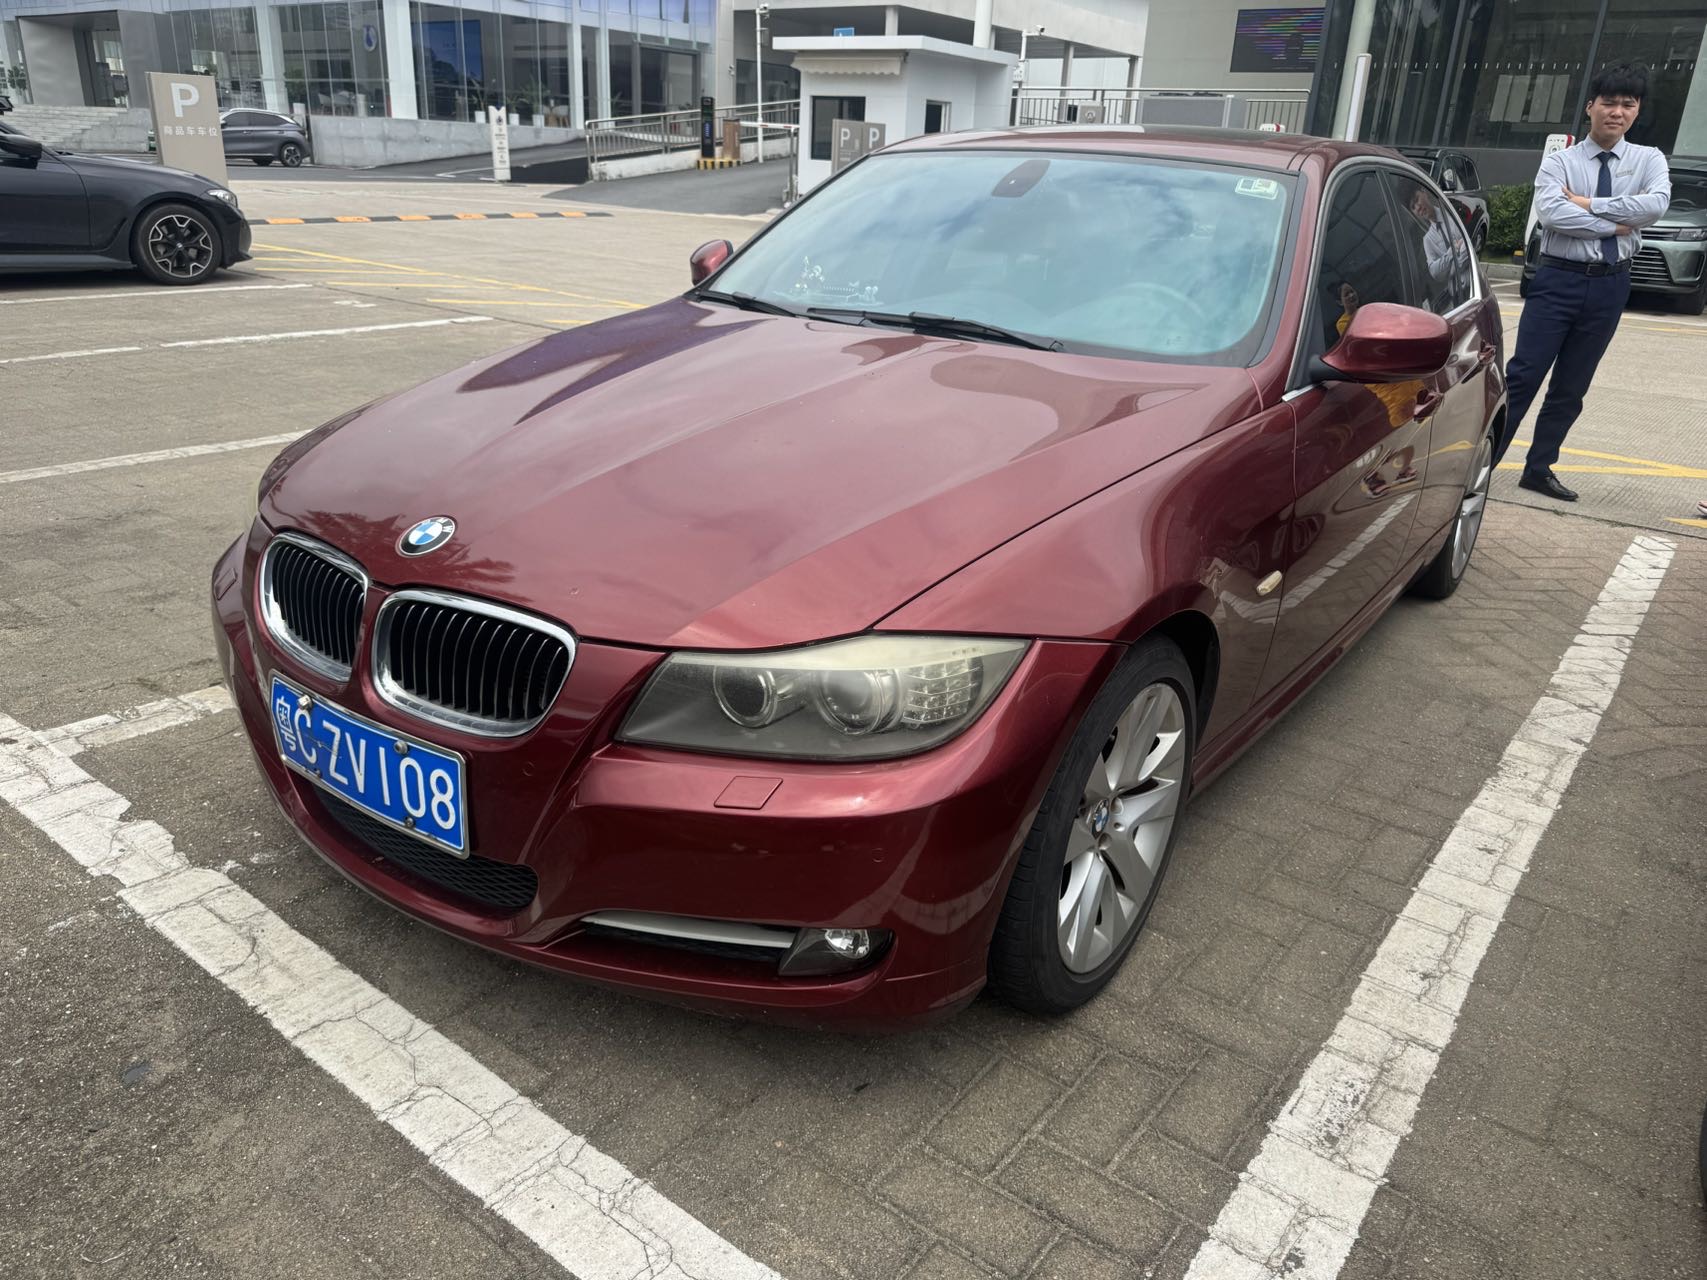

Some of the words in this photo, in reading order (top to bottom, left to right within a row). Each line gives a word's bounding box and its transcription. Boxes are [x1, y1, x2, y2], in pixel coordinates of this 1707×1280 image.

[170, 82, 200, 118] P
[840, 128, 851, 148] P
[869, 127, 880, 149] P
